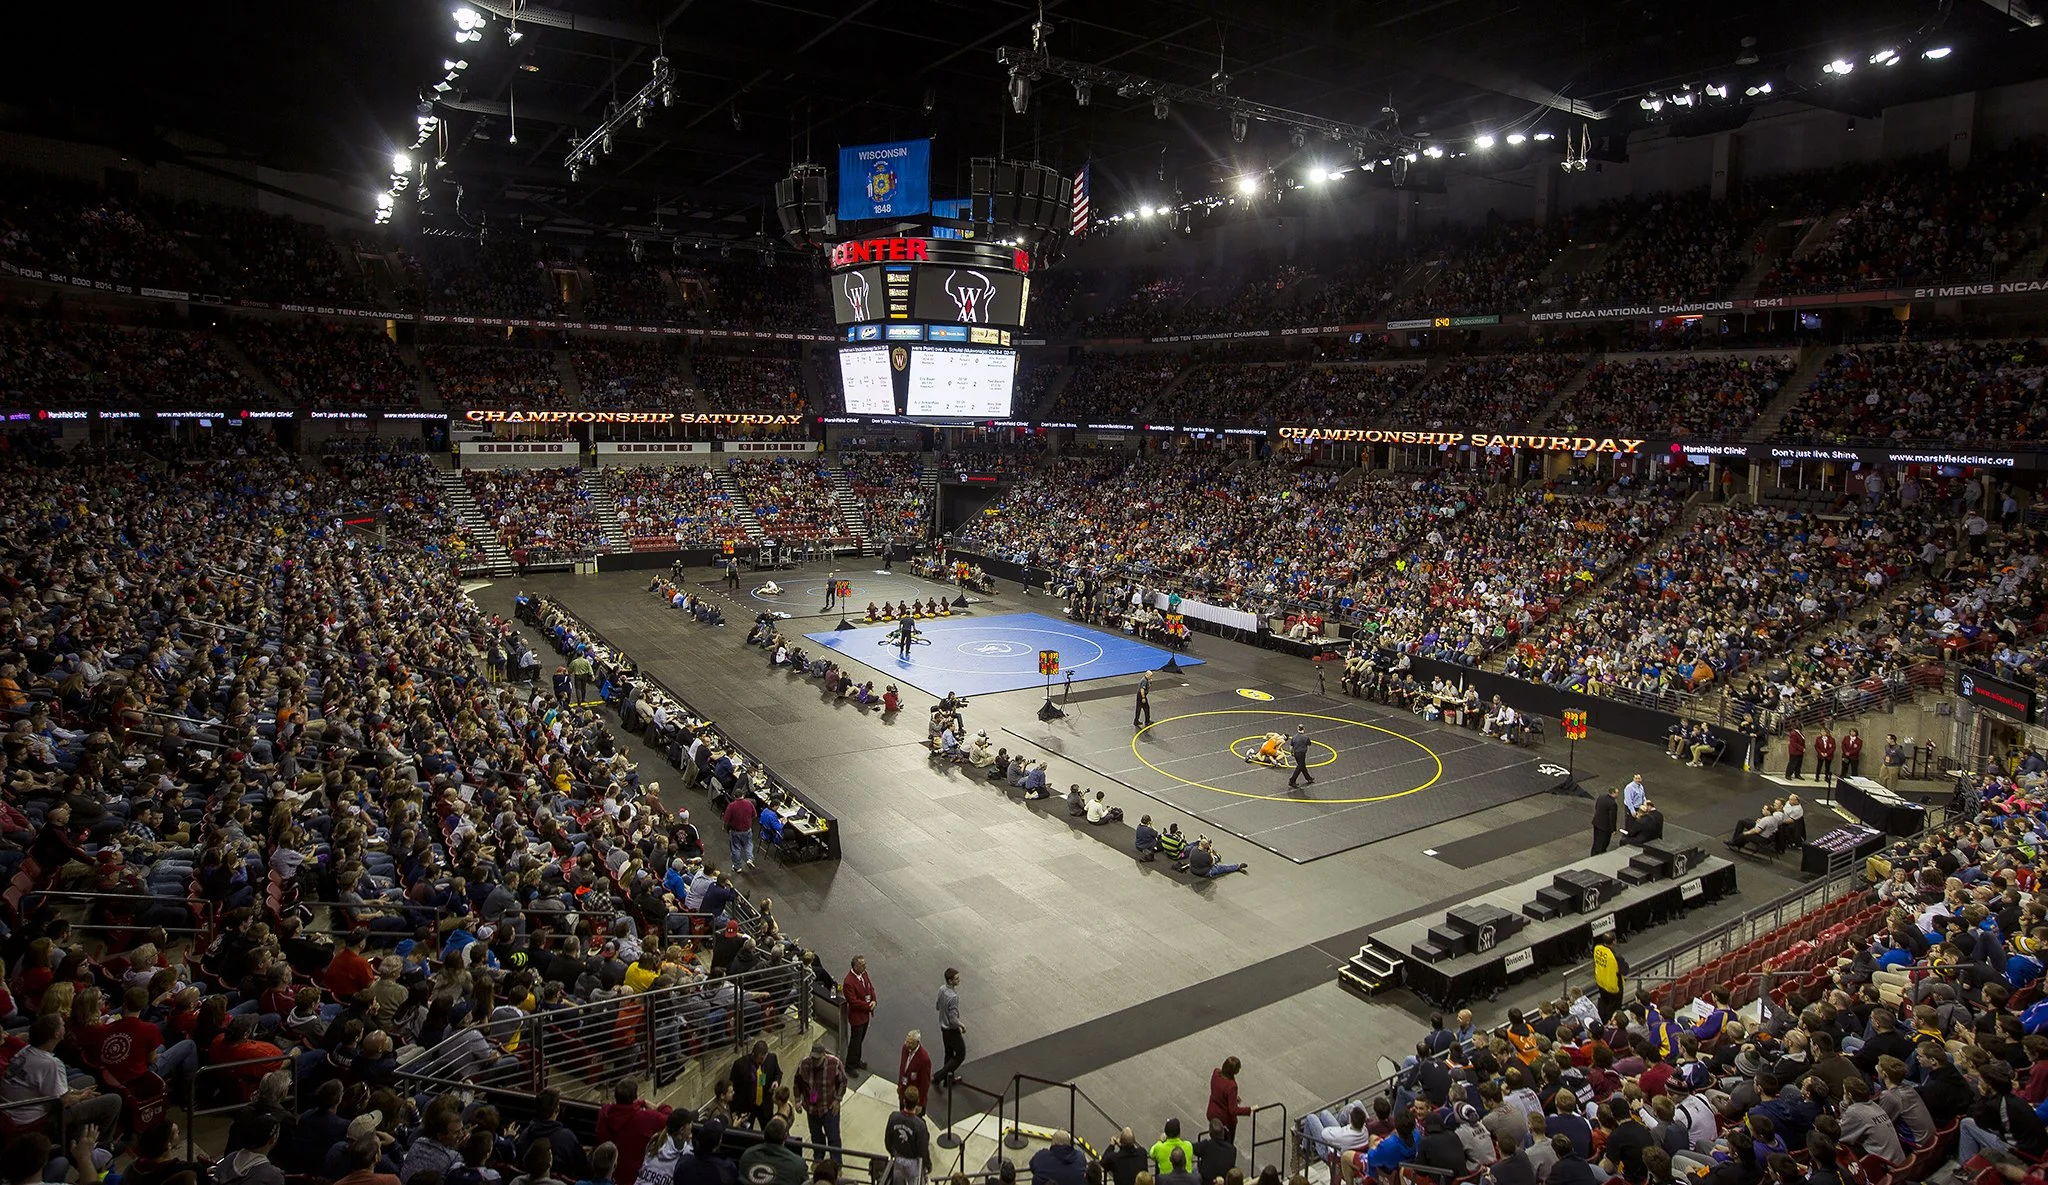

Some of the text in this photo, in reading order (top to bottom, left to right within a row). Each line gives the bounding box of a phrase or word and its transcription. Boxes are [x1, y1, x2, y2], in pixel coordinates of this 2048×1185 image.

[858, 148, 907, 161] WISCONSIN
[873, 204, 891, 214] 1848
[834, 238, 929, 265] CENTER
[19, 268, 43, 280] FOUR
[48, 273, 67, 283] 1941
[71, 277, 91, 287] 2000
[95, 281, 112, 290] 2014
[116, 285, 133, 294] 2015
[1914, 288, 1934, 298] 21
[1938, 284, 1994, 297] MEN'S
[281, 304, 315, 313] MEN'S
[317, 307, 335, 315] BIG
[337, 308, 356, 316] TEN
[358, 310, 414, 320] CHAMPIONS
[1531, 298, 1784, 321] MEN'S NCAA NATIONAL CHAMPIONS 1941
[1192, 332, 1232, 341] TOURNAMENT
[1233, 330, 1270, 338] CHAMPIONS
[465, 410, 803, 425] CHAMPIONSHIP SATURDAY
[1278, 426, 1645, 453] CHAMPIONSHIP SATURDAY
[1682, 445, 1747, 455] Marshfield Clinic
[1771, 448, 1859, 460] Don't just live. Shine.
[1889, 453, 2014, 467] www.marshfieldclinic.org
[1682, 882, 1695, 894] Division
[1592, 920, 1608, 931] Division
[1506, 951, 1528, 966] Division 3
[748, 1164, 774, 1184] G
